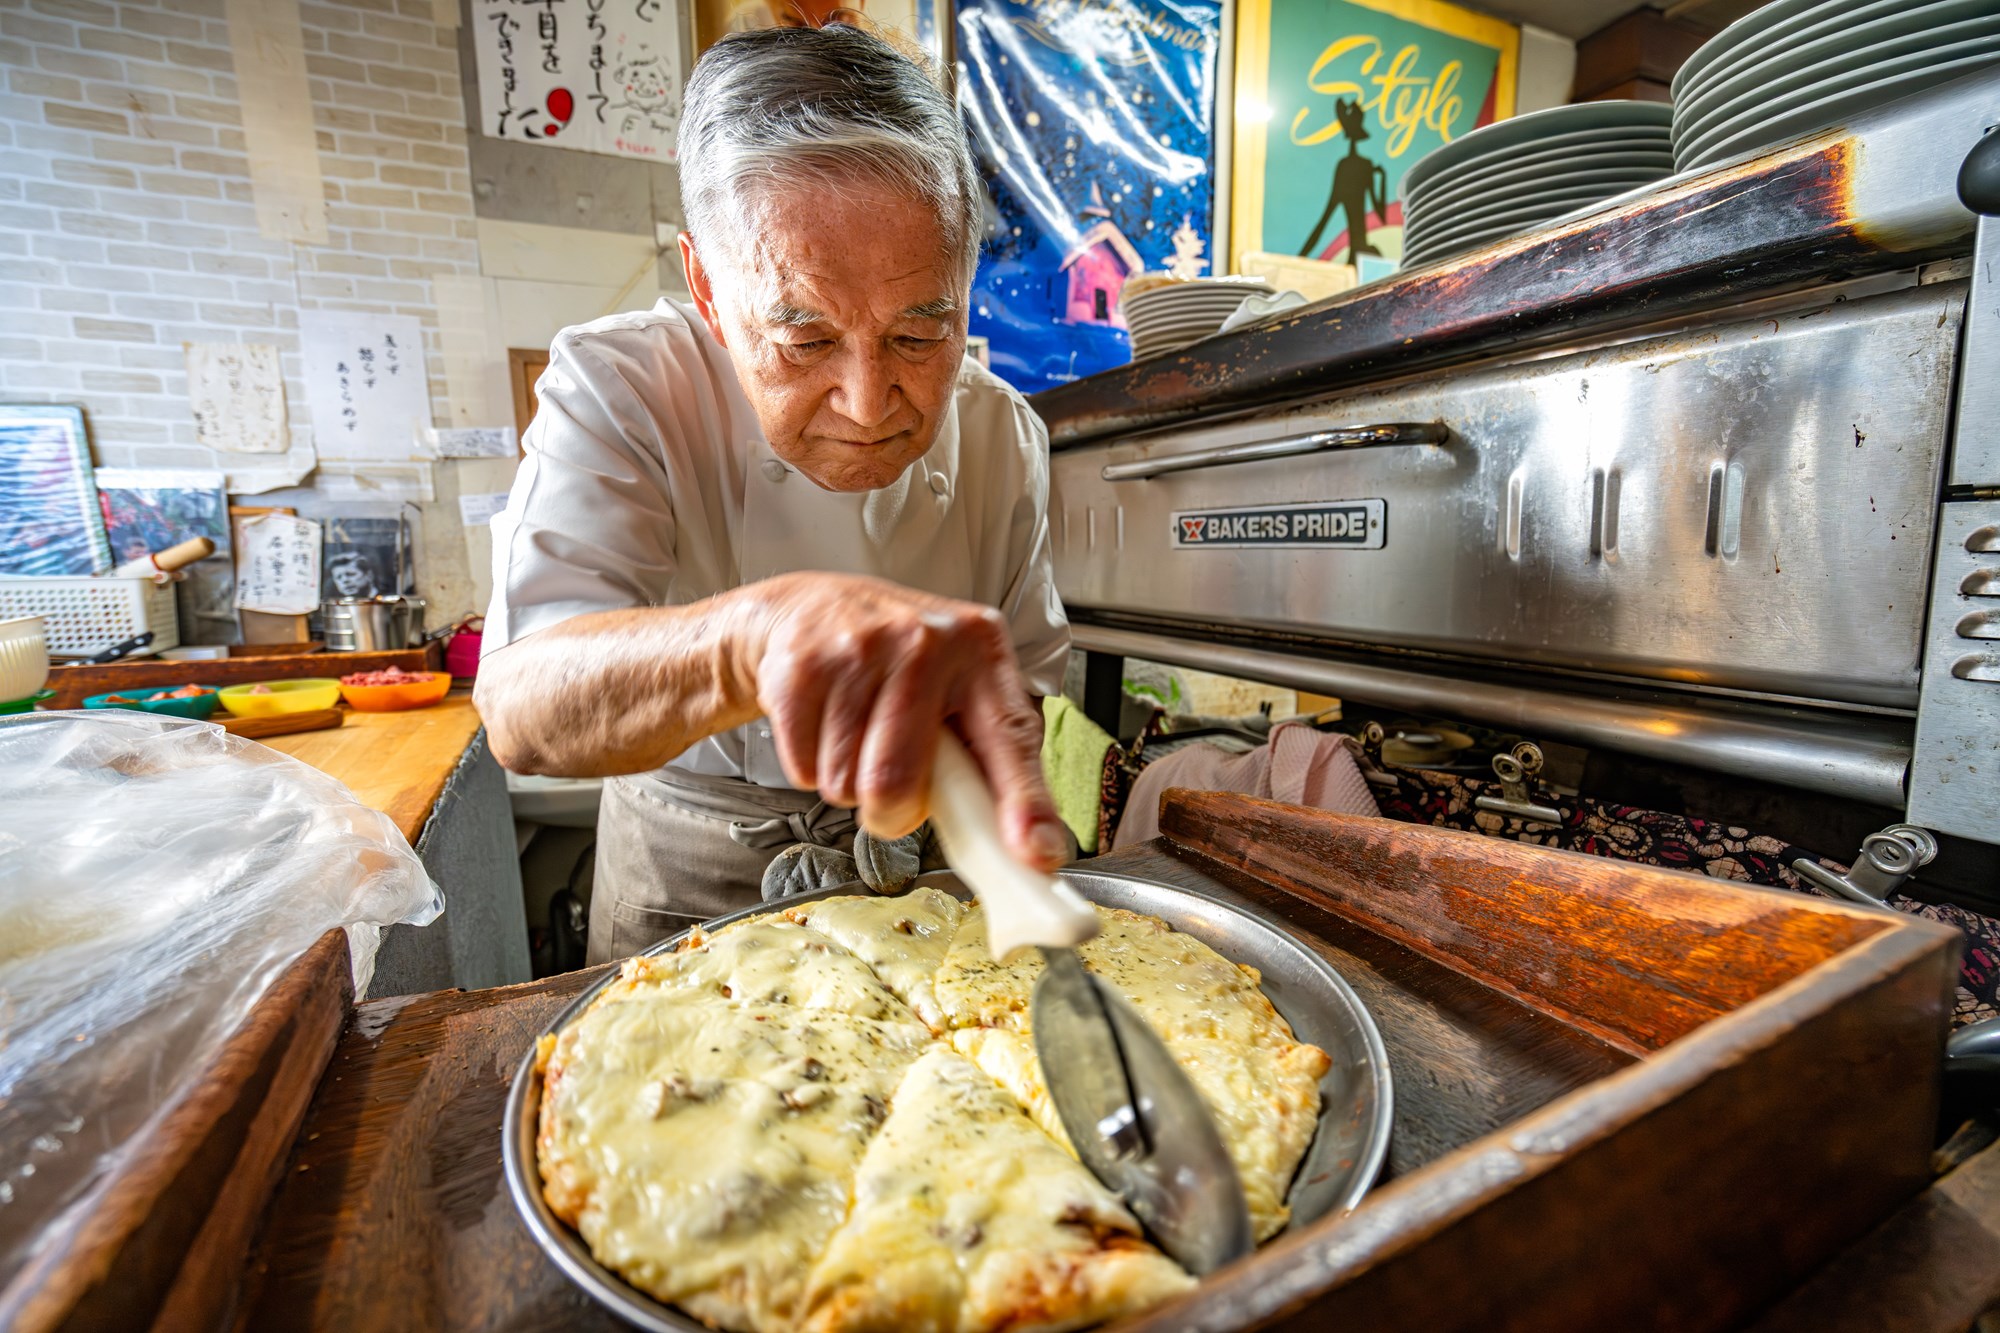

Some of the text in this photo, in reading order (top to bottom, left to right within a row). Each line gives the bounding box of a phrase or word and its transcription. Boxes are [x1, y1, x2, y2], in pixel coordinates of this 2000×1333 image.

[1290, 34, 1463, 159] Style
[1208, 512, 1365, 538] BAKERS PRIDE
